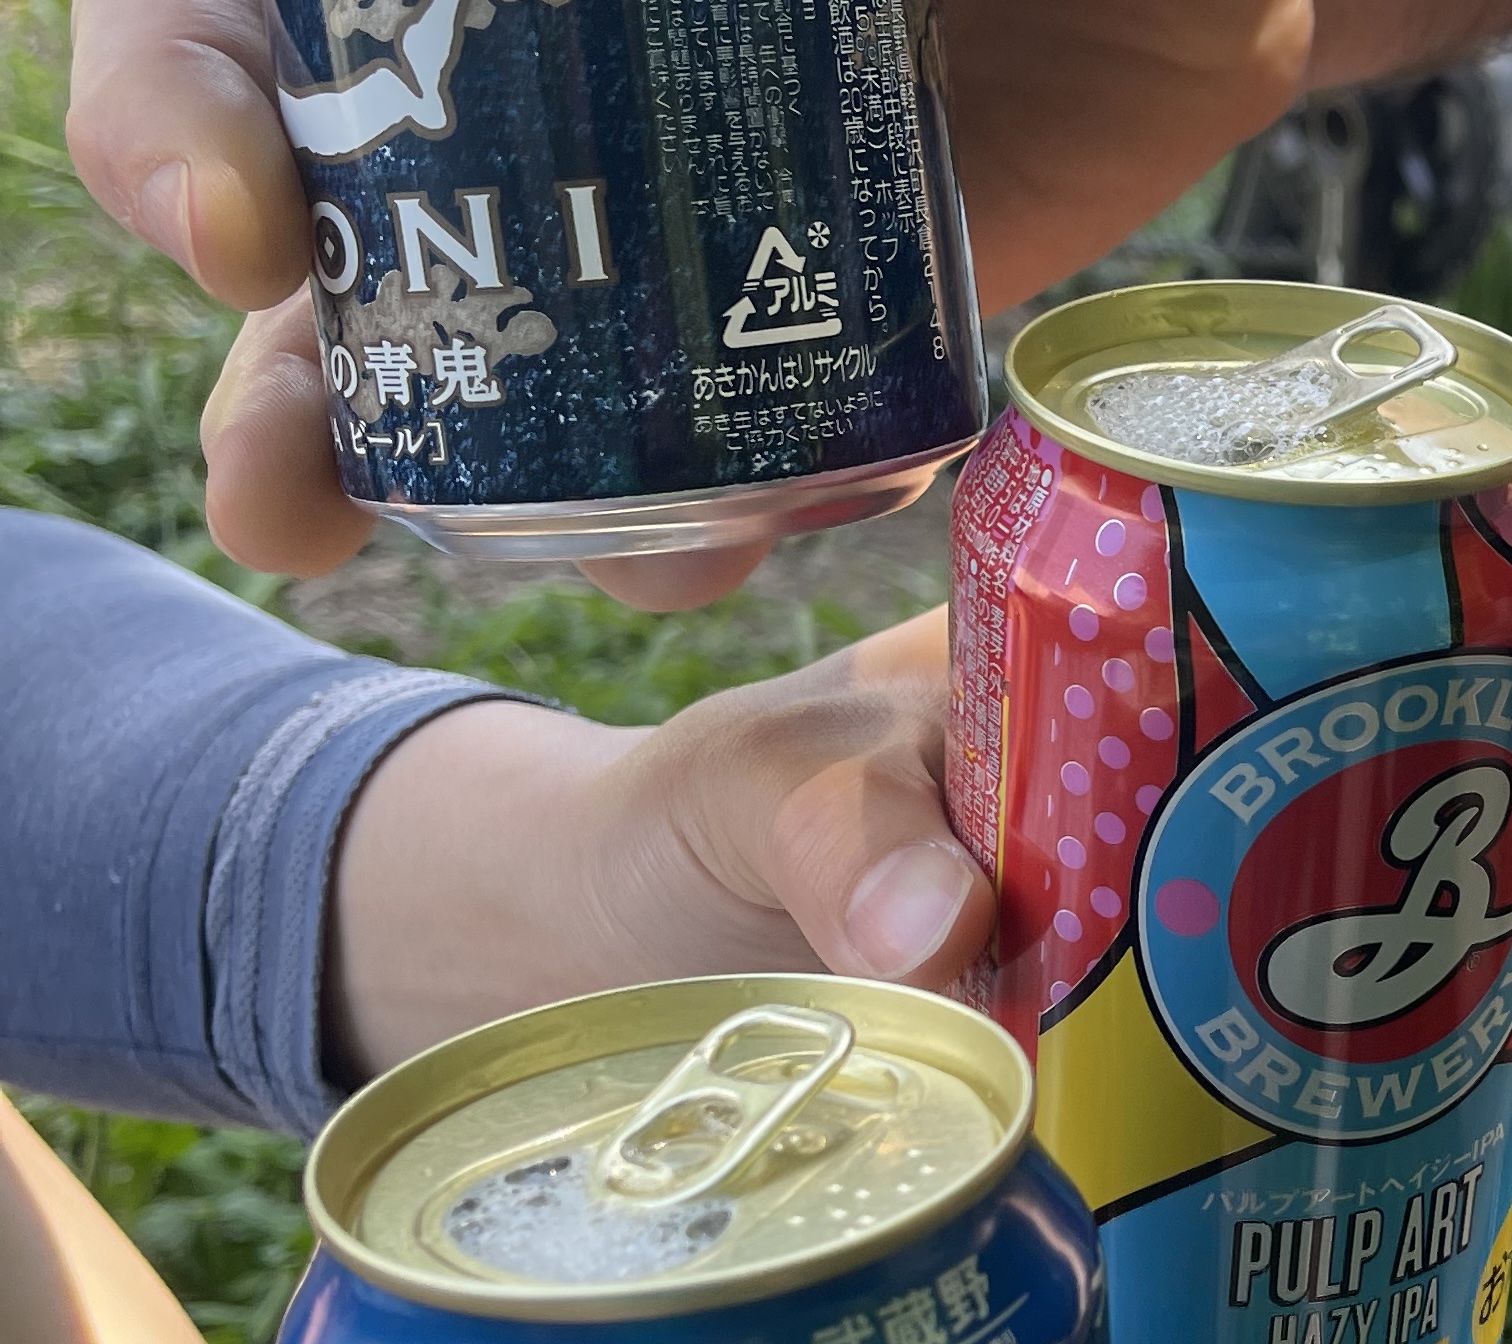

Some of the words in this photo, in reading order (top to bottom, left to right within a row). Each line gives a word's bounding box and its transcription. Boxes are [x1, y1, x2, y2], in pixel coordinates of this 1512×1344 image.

[764, 271, 840, 316] アルミ
[331, 338, 501, 406] の青鬼
[691, 344, 877, 401] あきかんはリサイクル
[1229, 1207, 1384, 1308] PULP
[1390, 1164, 1485, 1285] ART
